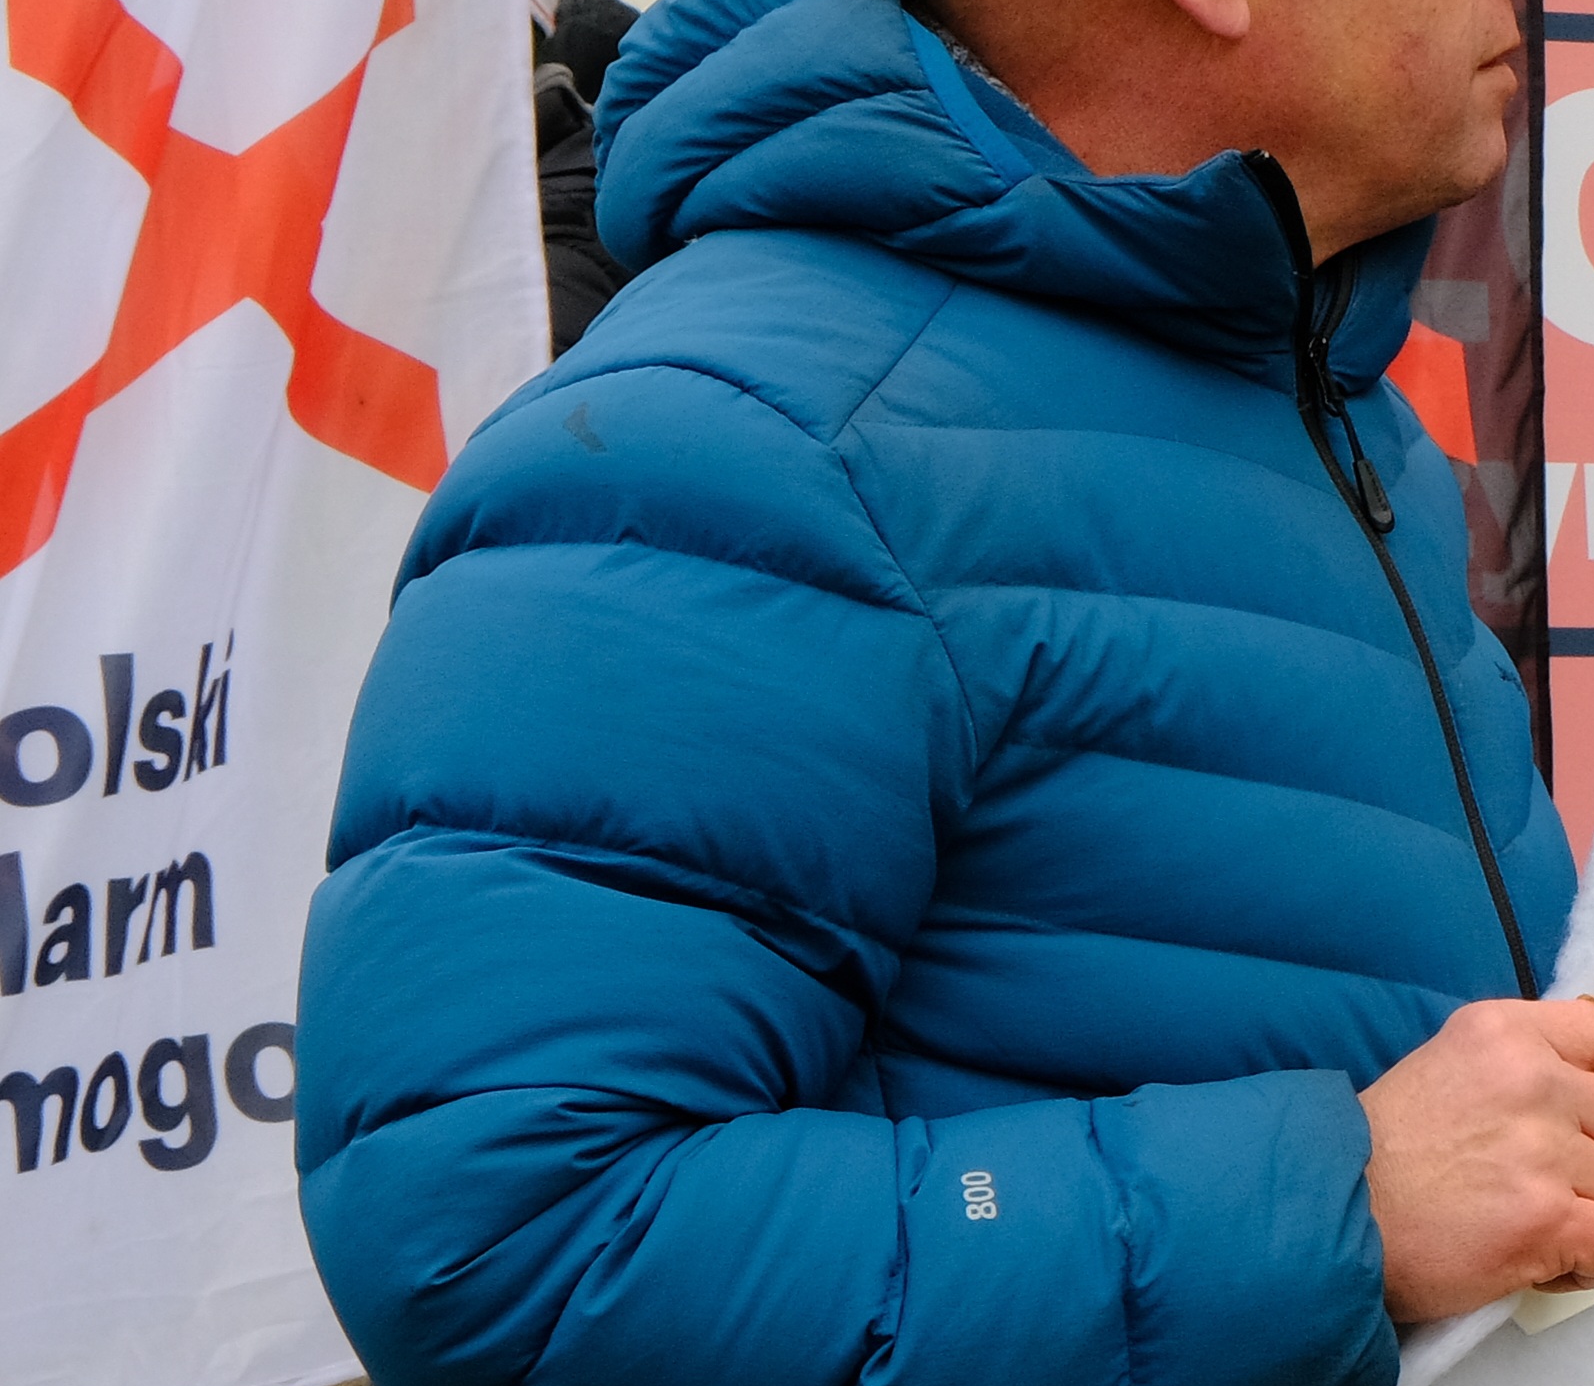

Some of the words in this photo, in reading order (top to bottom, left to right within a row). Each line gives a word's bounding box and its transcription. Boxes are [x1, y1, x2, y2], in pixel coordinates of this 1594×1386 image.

[0, 627, 235, 808] olski
[0, 851, 217, 997] larm
[0, 1021, 297, 1174] mogo
[960, 1171, 998, 1221] 800
